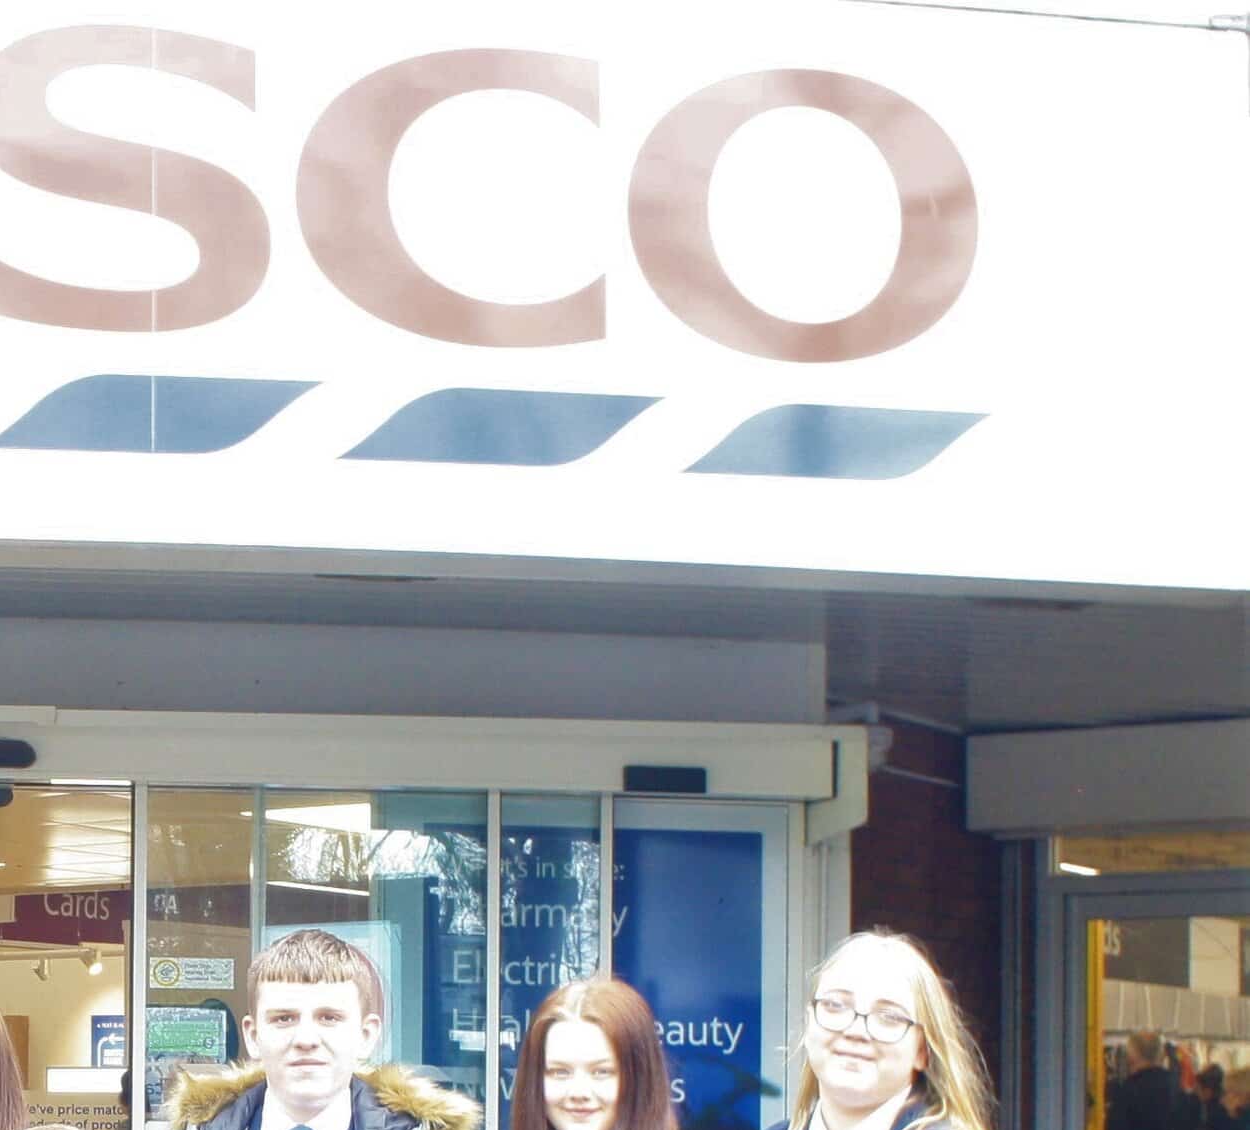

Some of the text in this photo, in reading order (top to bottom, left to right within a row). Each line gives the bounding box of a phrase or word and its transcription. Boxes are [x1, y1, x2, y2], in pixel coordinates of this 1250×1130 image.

[43, 892, 111, 921] Cards
[653, 1016, 744, 1055] eauty
[58, 1104, 89, 1117] price
[76, 1118, 88, 1129] of
